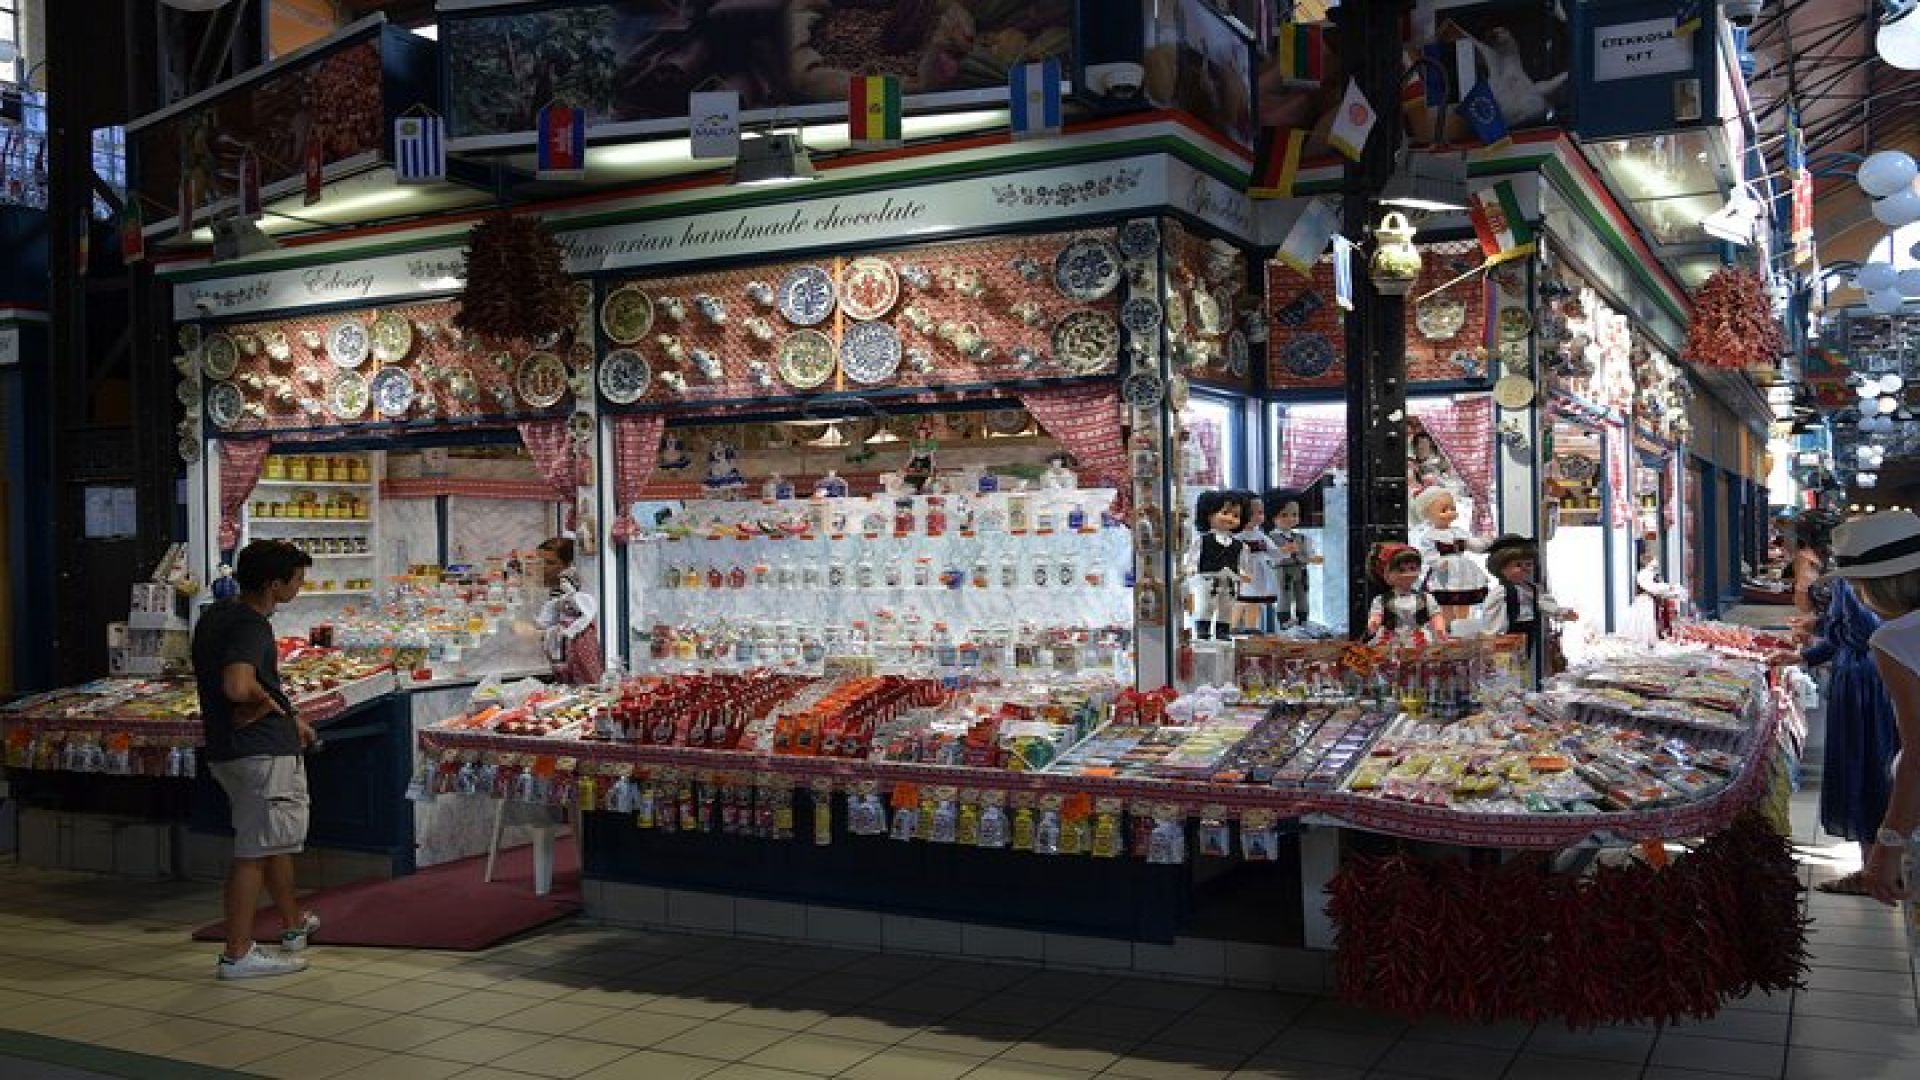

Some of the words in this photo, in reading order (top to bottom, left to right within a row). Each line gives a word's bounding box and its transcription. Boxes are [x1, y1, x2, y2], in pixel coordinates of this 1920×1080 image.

[1626, 50, 1653, 62] KFT
[680, 209, 808, 247] handmade
[814, 197, 926, 231] chocolate
